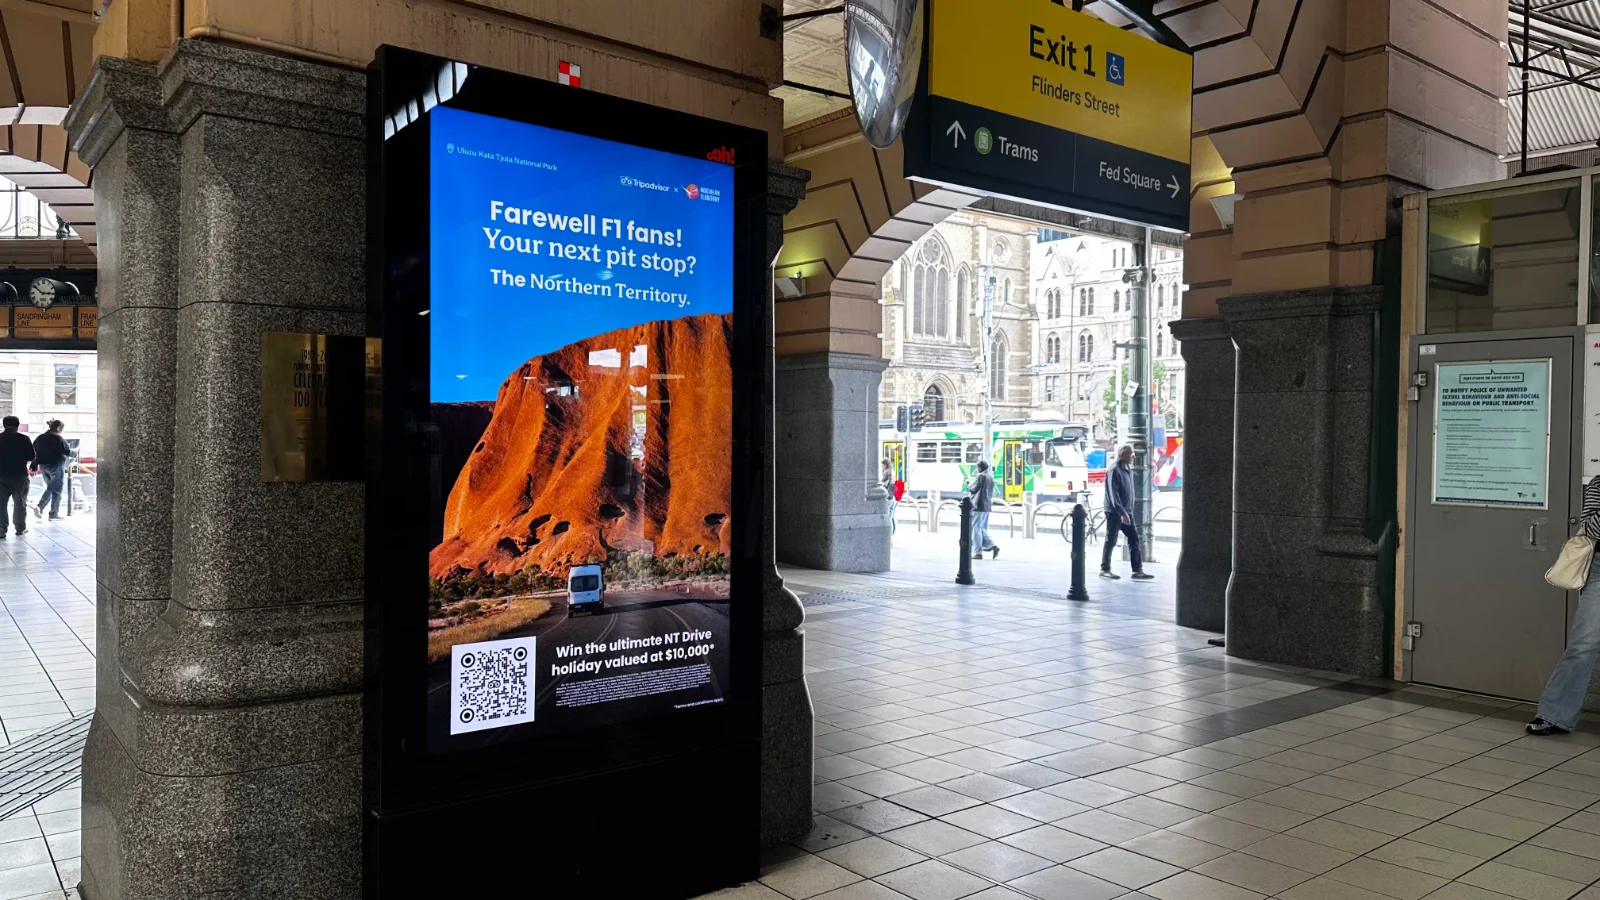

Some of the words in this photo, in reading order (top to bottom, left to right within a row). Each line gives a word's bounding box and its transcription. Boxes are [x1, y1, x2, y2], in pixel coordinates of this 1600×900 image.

[1029, 24, 1077, 71] Exit
[1083, 45, 1096, 77] 1
[1031, 75, 1081, 106] Flinders
[1084, 91, 1120, 117] Street
[514, 157, 542, 168] National
[542, 163, 558, 171] Park
[998, 136, 1039, 162] Trams
[633, 178, 670, 192] Tripadvisor
[1099, 161, 1120, 182] Fed
[1123, 167, 1161, 191] Square
[490, 200, 596, 235] Farewell
[602, 217, 621, 239] F1
[627, 220, 682, 247] fans!
[482, 227, 543, 254] Your
[549, 241, 601, 263] next
[606, 246, 637, 269] pit
[641, 252, 697, 277] stop?
[490, 269, 526, 287] The
[530, 273, 612, 297] Northern
[615, 283, 691, 307] Territory.
[294, 391, 310, 408] 100
[556, 645, 583, 658] Win
[585, 641, 606, 655] the
[608, 635, 662, 652] ultimate
[664, 632, 680, 645] NT
[682, 628, 712, 643] Drive
[551, 658, 602, 676] holiday
[604, 654, 648, 669] valued
[650, 650, 663, 663] at
